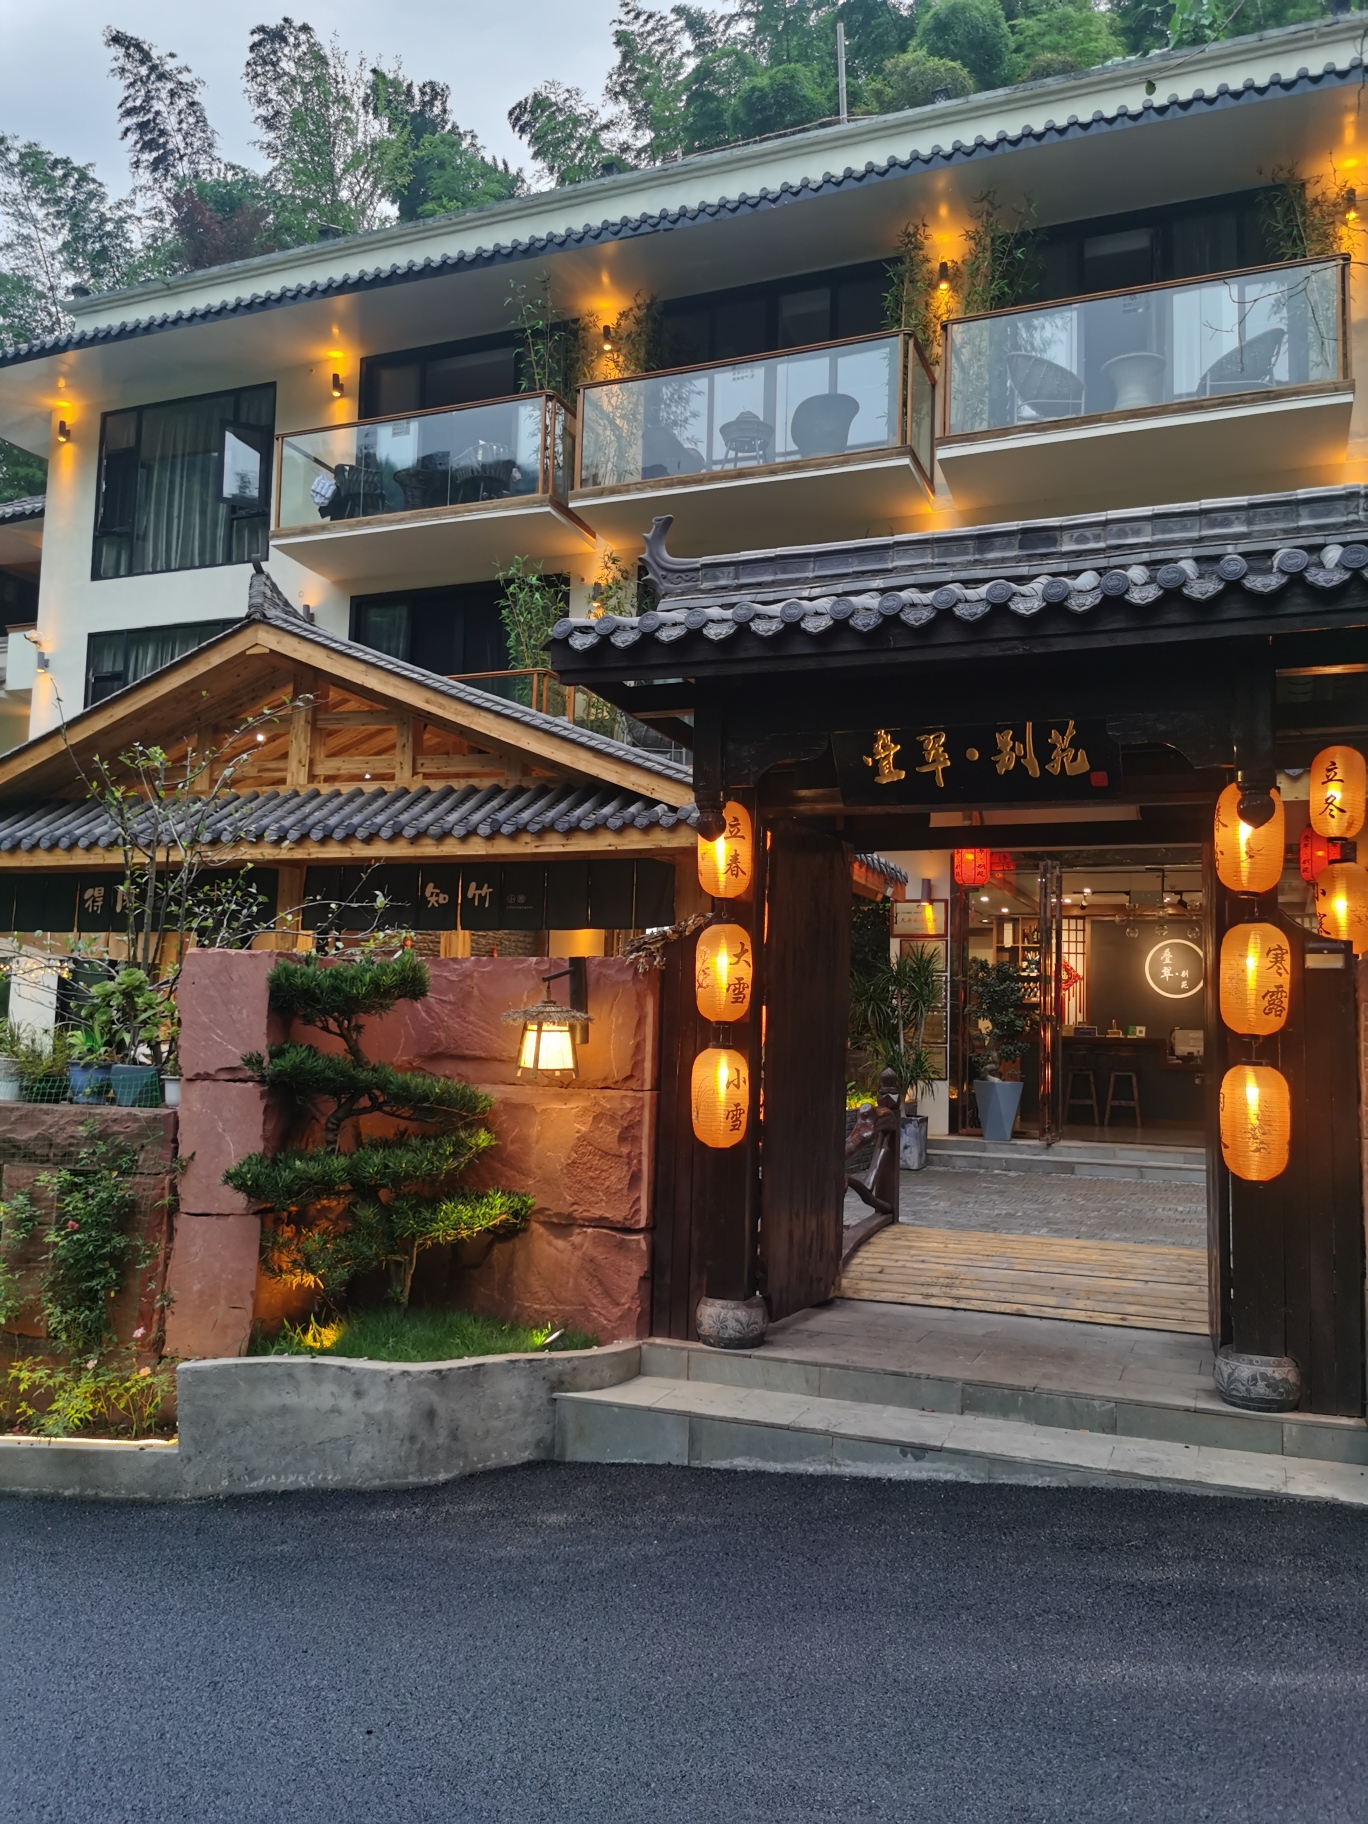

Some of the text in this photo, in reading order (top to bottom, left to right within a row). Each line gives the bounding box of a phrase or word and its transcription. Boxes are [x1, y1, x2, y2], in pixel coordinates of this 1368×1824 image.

[1319, 761, 1347, 819] 立冬
[724, 816, 746, 879] 立春
[726, 941, 751, 1004] 大雪
[1262, 944, 1289, 1018] 寒露
[725, 1067, 747, 1132] 小雪
